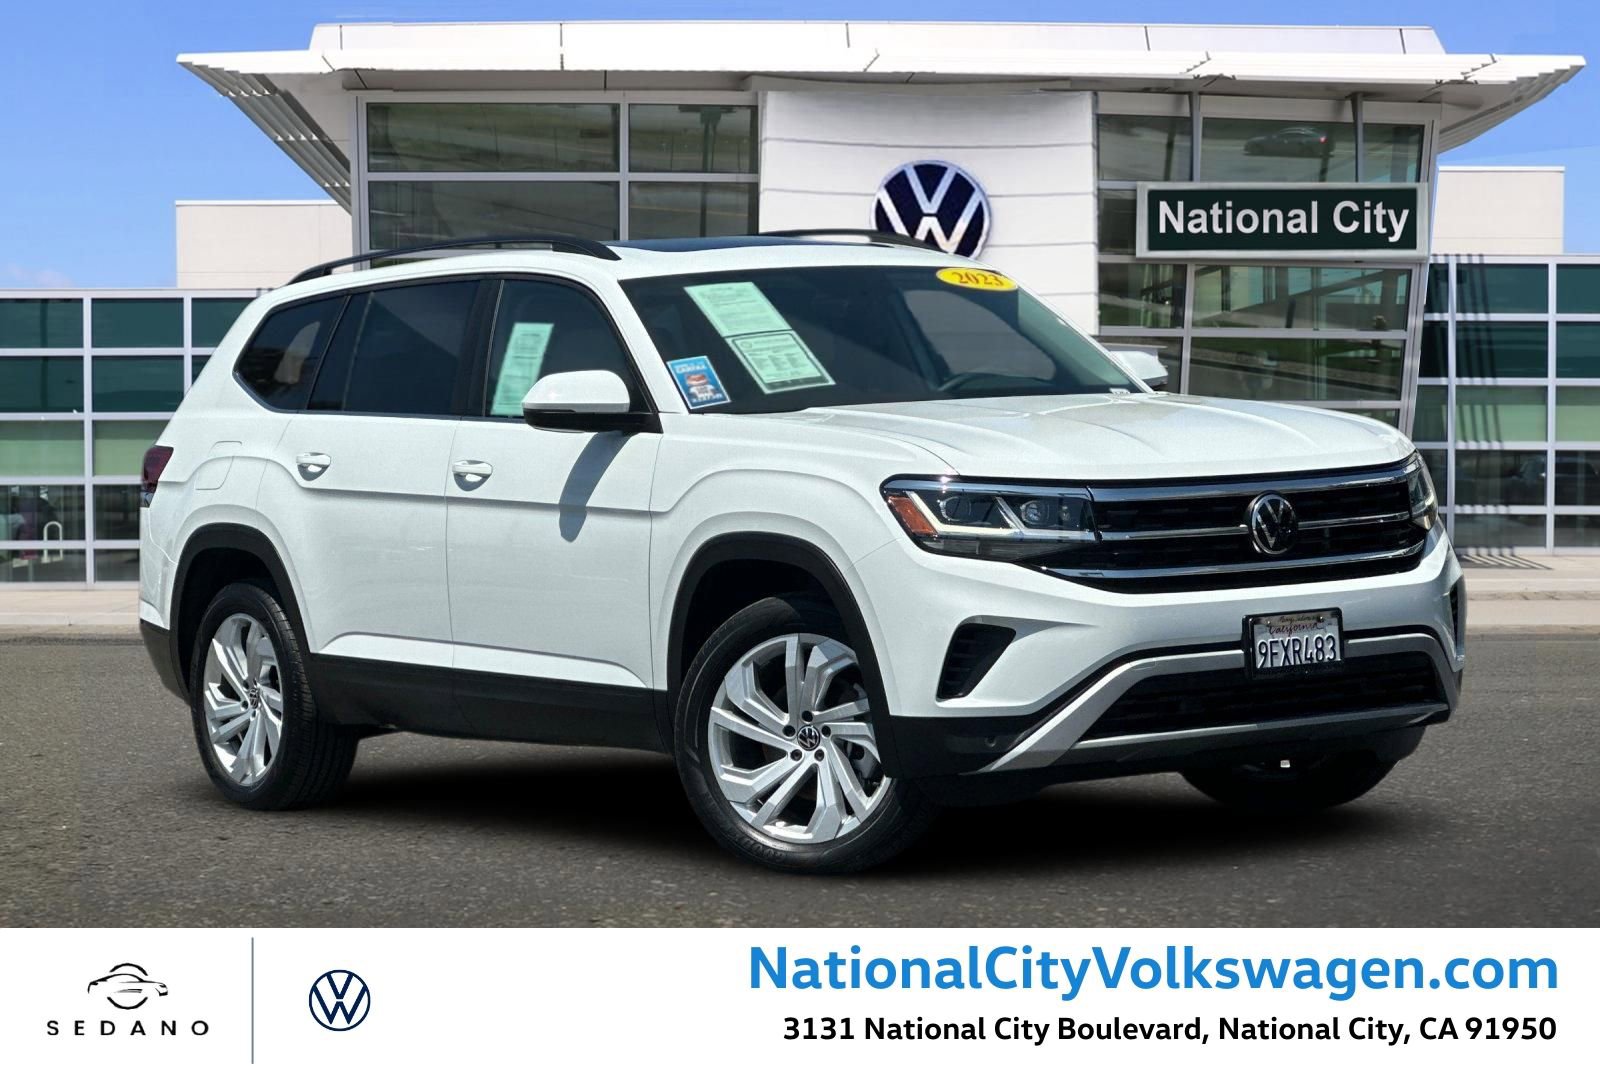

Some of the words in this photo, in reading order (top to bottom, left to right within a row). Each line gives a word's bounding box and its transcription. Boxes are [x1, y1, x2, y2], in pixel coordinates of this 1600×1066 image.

[1158, 200, 1318, 234] National
[1333, 200, 1410, 242] City
[951, 271, 1004, 286] 2023
[1269, 622, 1324, 637] California
[1256, 633, 1337, 669] 9FXR483
